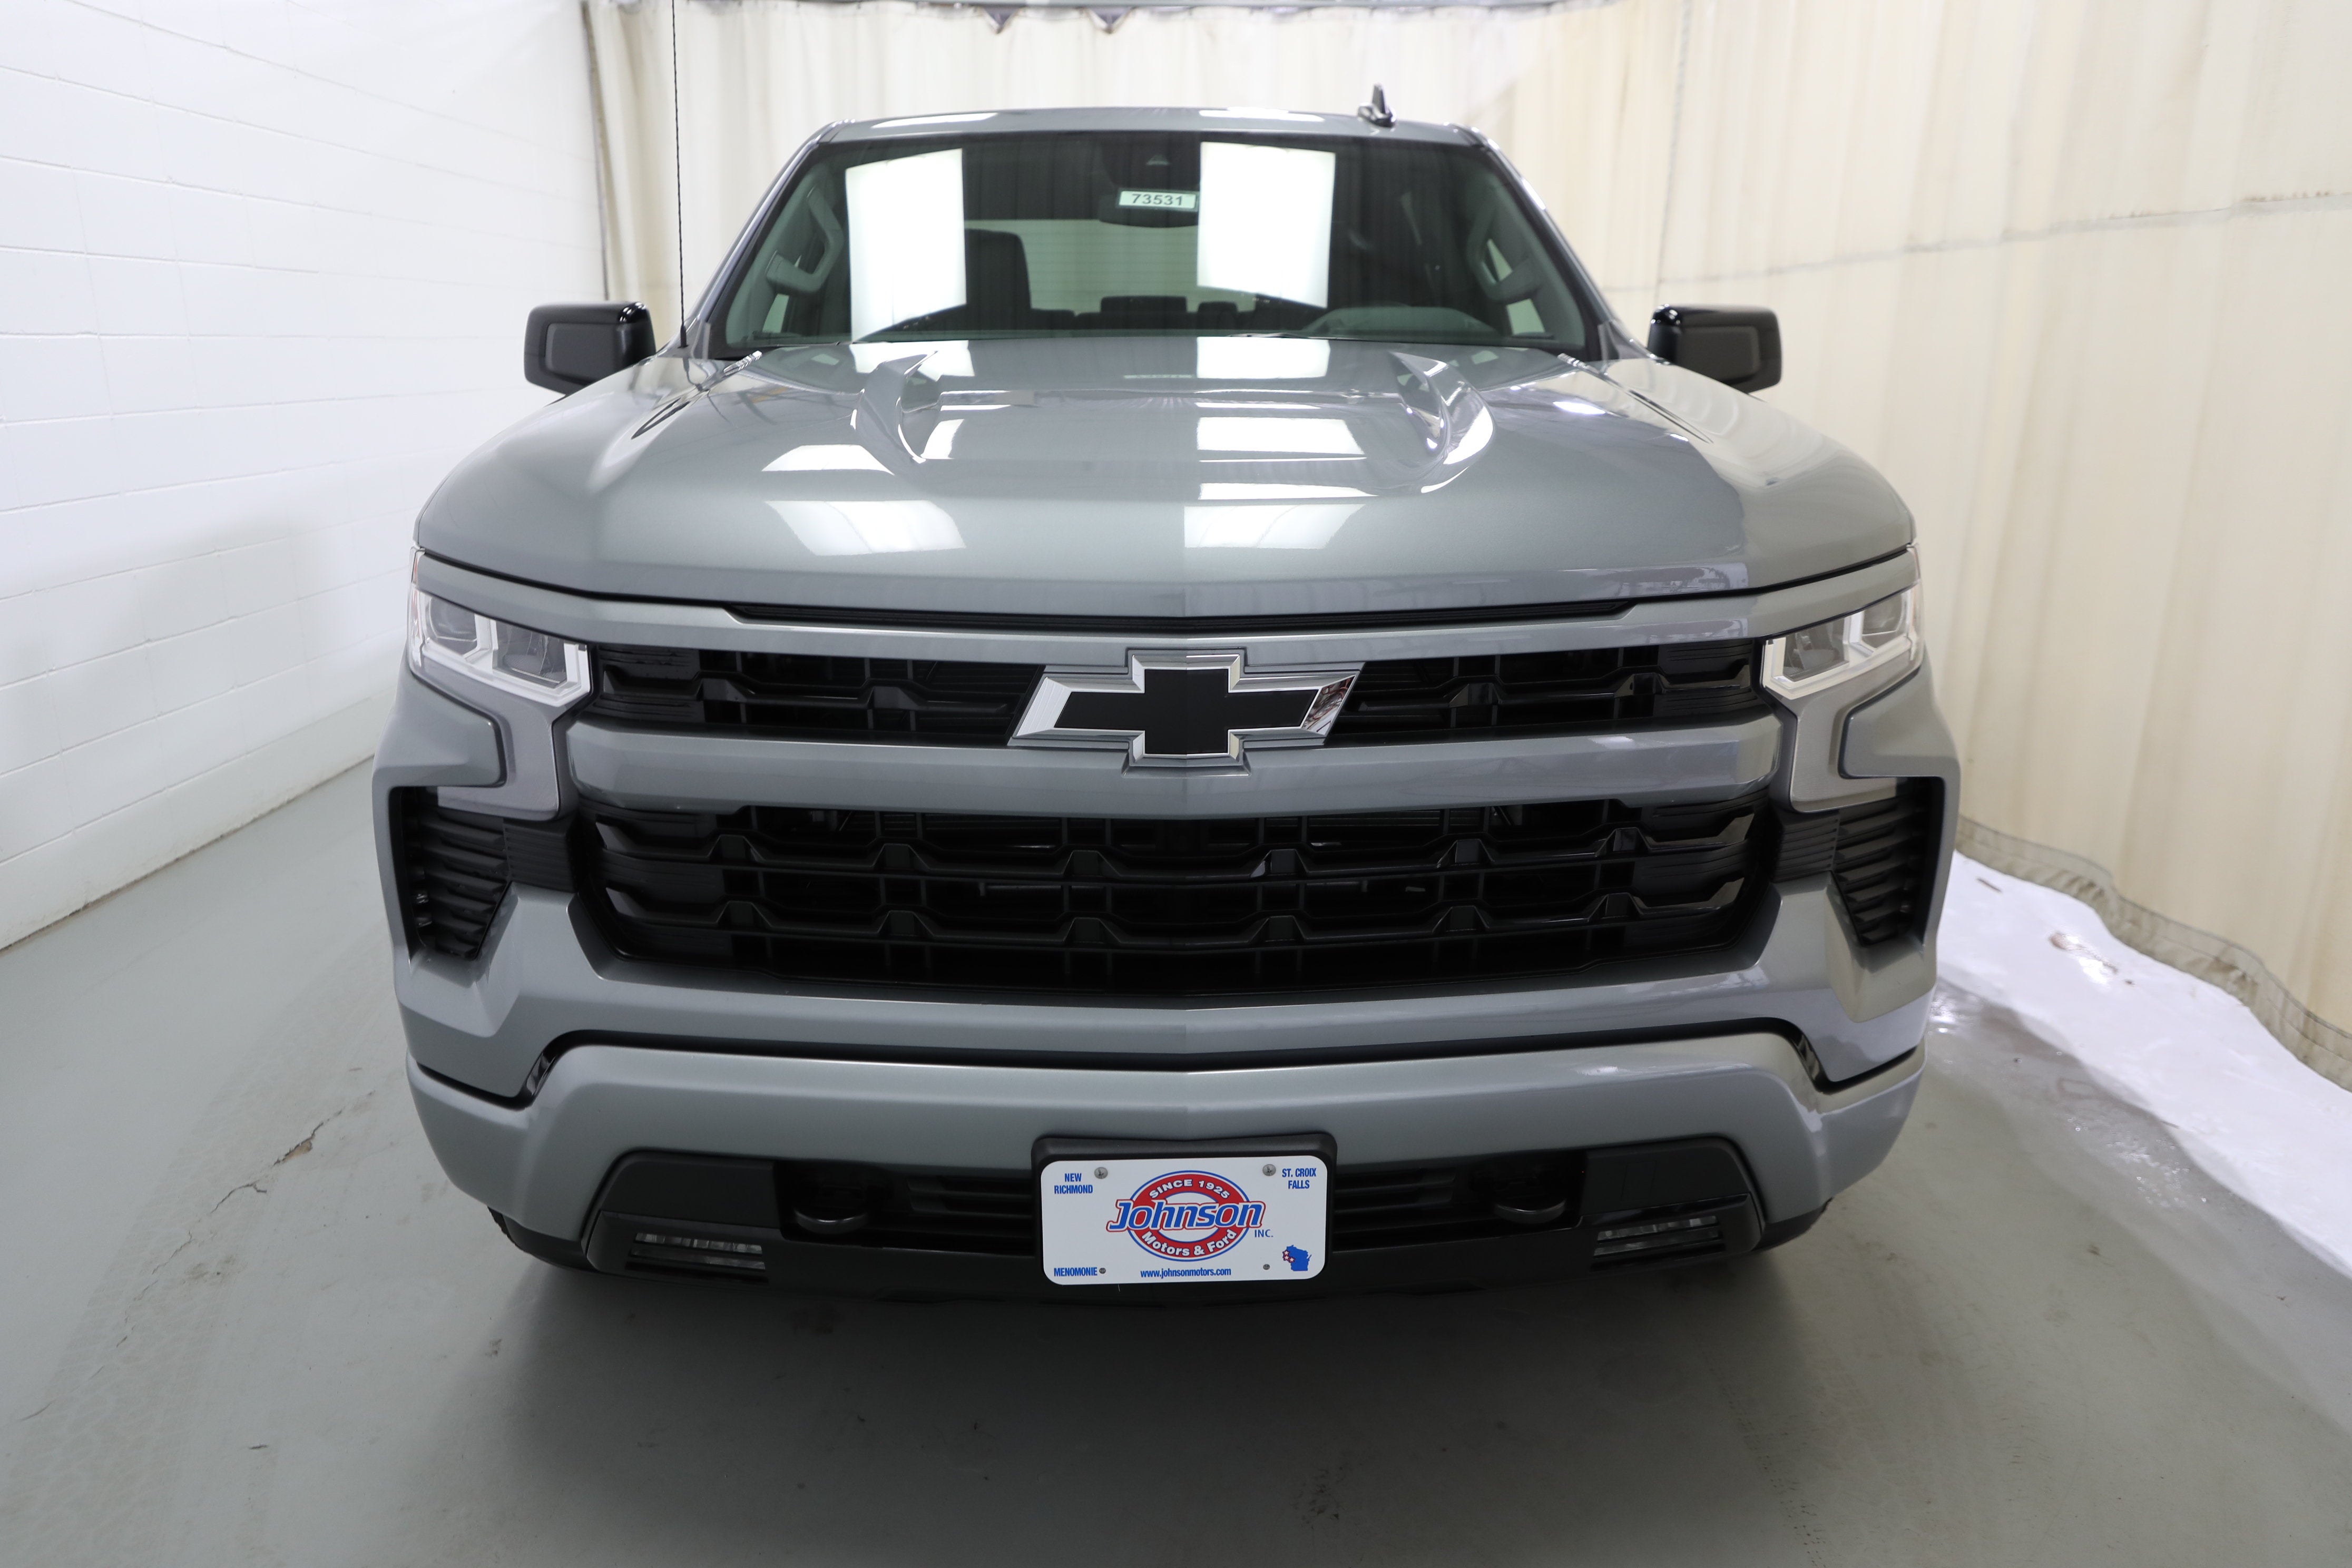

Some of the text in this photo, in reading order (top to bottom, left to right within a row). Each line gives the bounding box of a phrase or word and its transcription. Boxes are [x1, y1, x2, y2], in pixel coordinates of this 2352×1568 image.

[1132, 193, 1183, 206] 73531
[1064, 1173, 1082, 1182] NEW
[1282, 1168, 1317, 1177] ST. CROIX
[1054, 1184, 1093, 1194] RICHMOND
[1149, 1179, 1231, 1199] SINCE 1925
[1288, 1180, 1310, 1189] FALLS
[1108, 1200, 1264, 1231] Johnson
[1254, 1229, 1273, 1238] INC.
[1141, 1229, 1237, 1256] Motors & Ford
[1054, 1267, 1097, 1277] MENOMONIE
[1140, 1268, 1231, 1279] www.johnsonmotors.com
